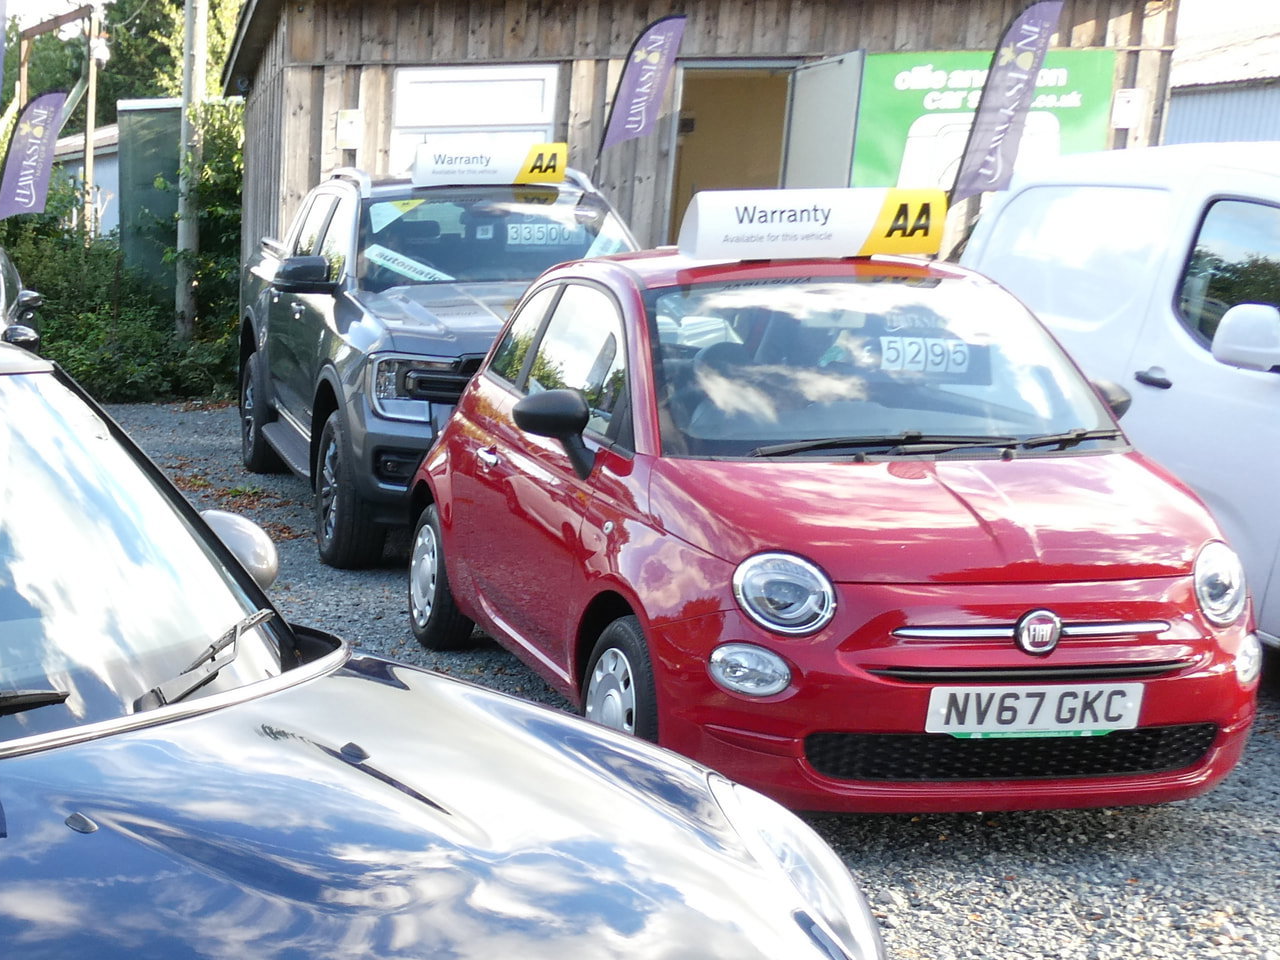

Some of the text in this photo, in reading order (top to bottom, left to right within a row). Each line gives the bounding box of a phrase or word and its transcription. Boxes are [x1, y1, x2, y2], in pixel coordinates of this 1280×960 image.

[433, 153, 491, 168] Warranty
[529, 152, 558, 174] AA
[735, 204, 832, 226] Warranty
[885, 203, 932, 238] AA
[510, 225, 571, 241] 33500
[723, 231, 833, 244] Available for this vehicle
[1029, 623, 1053, 643] FIAT
[943, 689, 1127, 726] NV67 GKC
